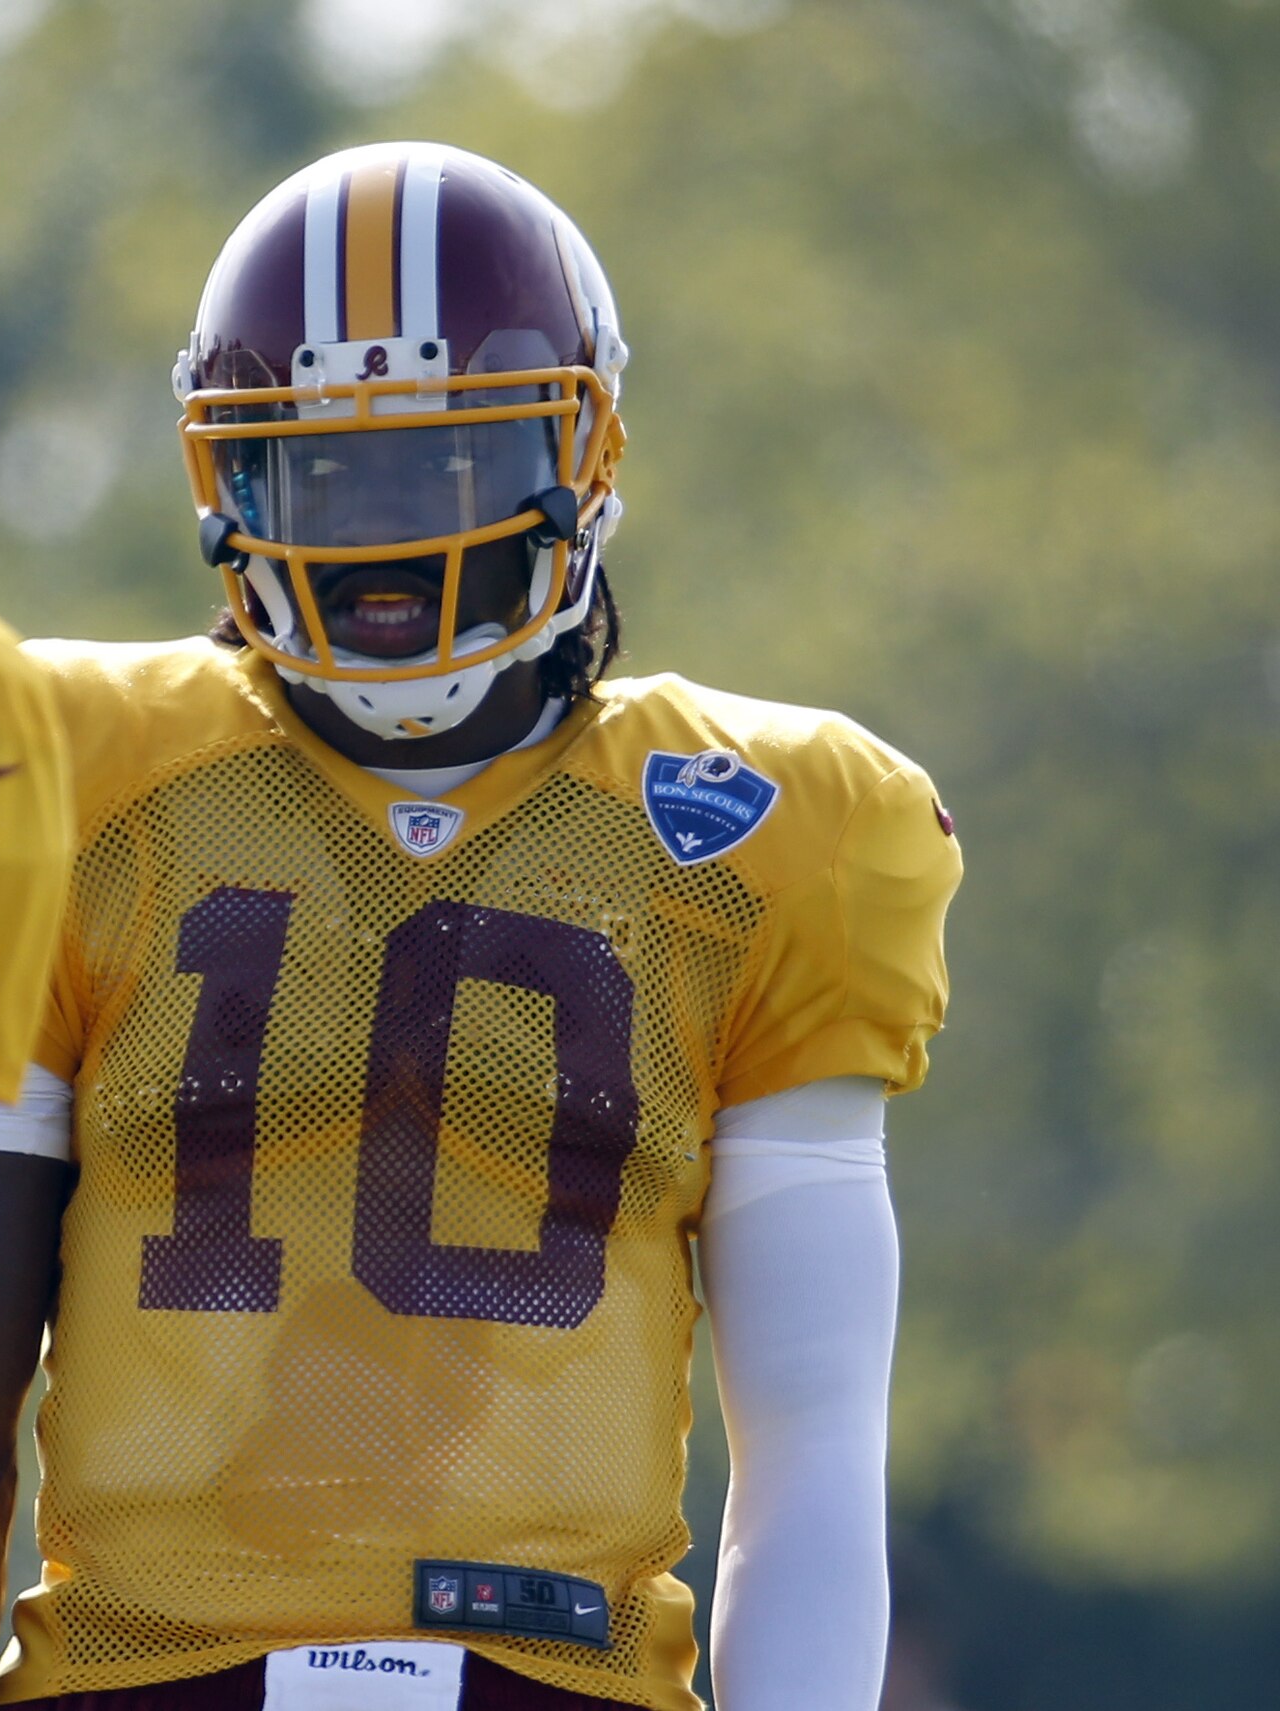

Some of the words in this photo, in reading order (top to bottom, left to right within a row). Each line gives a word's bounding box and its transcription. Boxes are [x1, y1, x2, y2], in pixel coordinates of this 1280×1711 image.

[397, 807, 454, 819] EQUIPMENT
[654, 784, 687, 797] BON
[691, 789, 753, 820] SECOURS
[704, 811, 737, 831] CENTER
[410, 827, 435, 844] NFL
[138, 885, 639, 1329] 10
[431, 1591, 453, 1609] NFL
[519, 1577, 555, 1605] 50
[308, 1649, 417, 1676] Wilson
